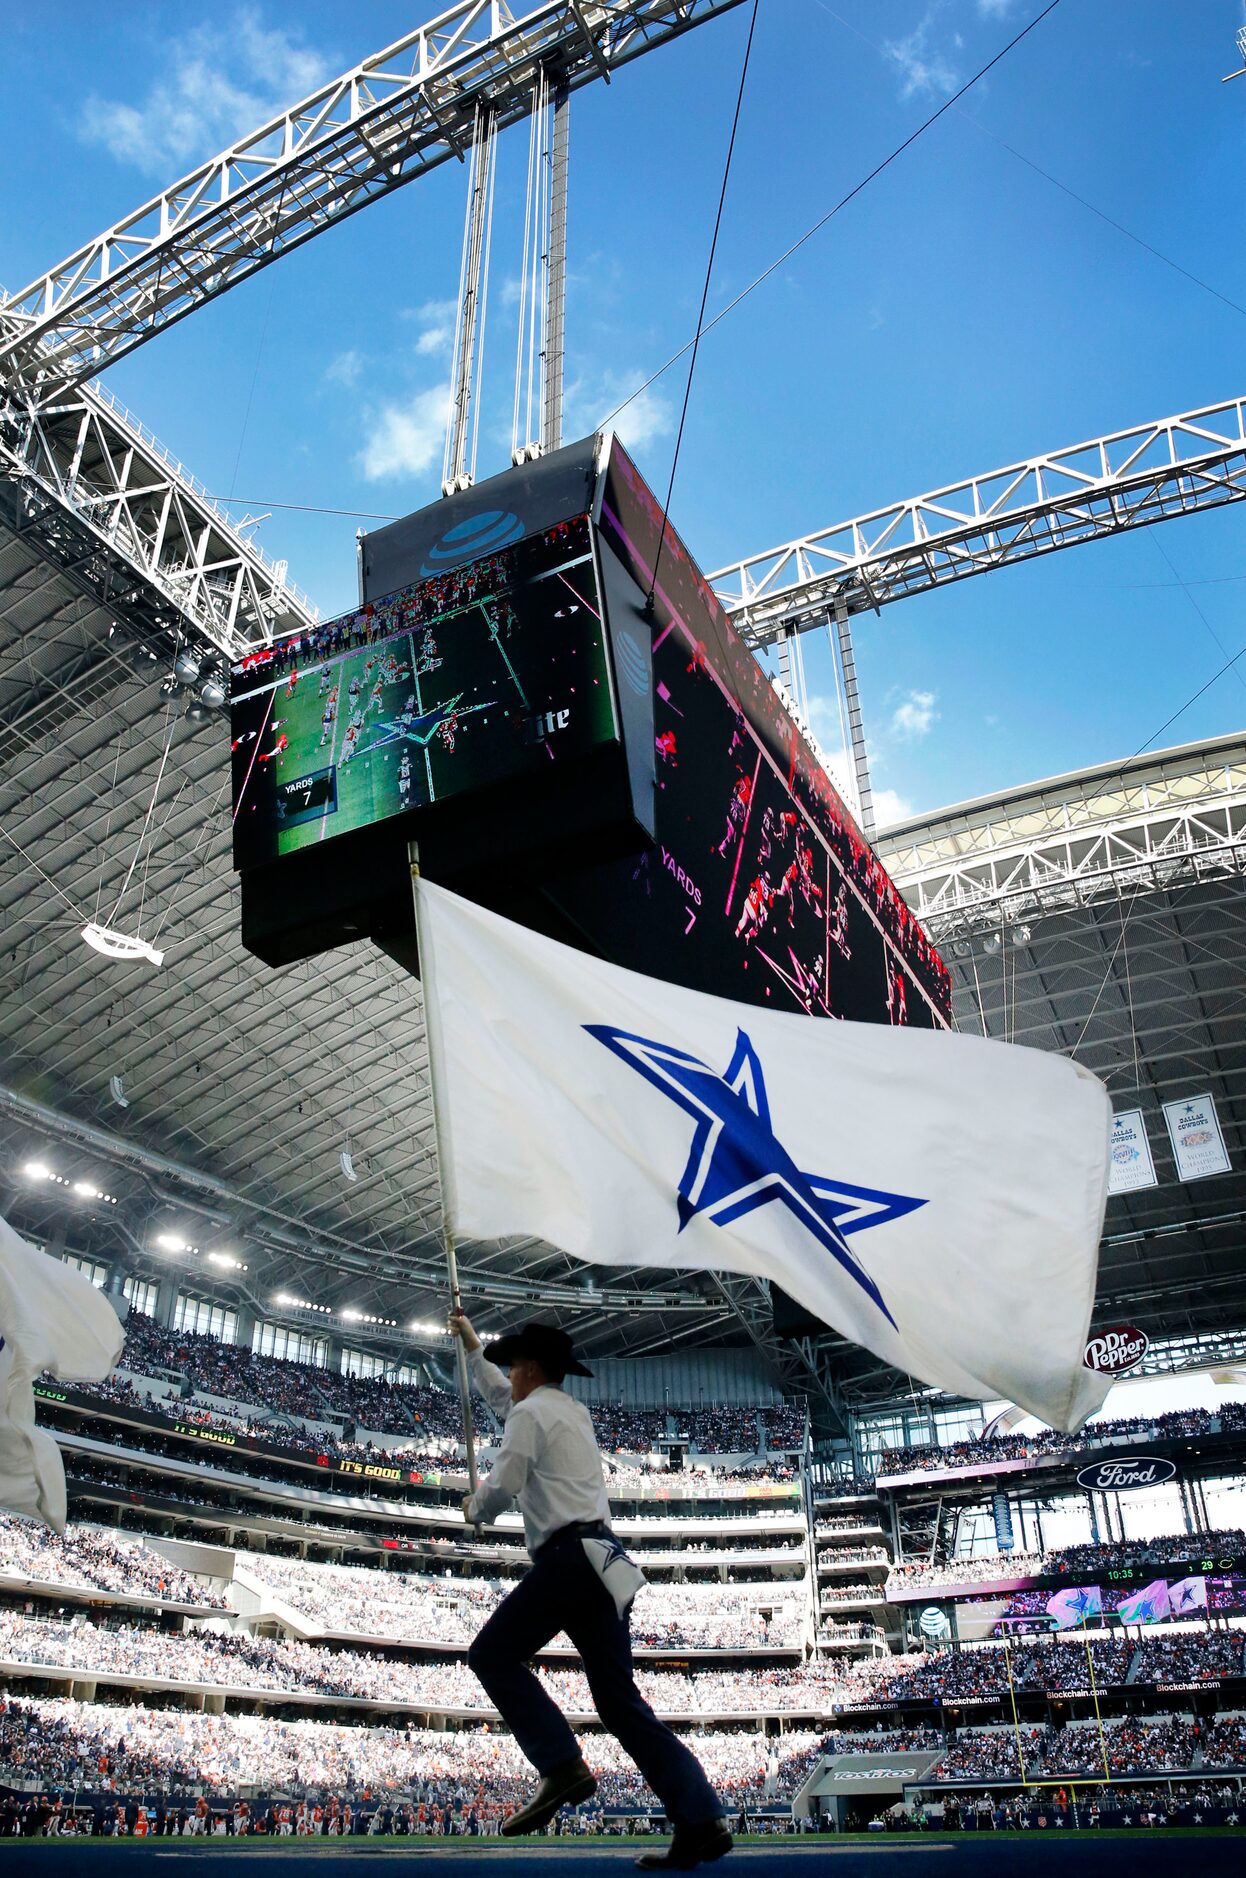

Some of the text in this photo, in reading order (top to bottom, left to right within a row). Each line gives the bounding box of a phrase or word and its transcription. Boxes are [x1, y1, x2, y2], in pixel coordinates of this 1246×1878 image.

[285, 777, 313, 794] YARDS
[303, 791, 311, 806] 7
[661, 845, 701, 905] YARDS
[1179, 1113, 1204, 1124] DALLAS
[1177, 1119, 1208, 1130] COWBOYS
[1110, 1134, 1137, 1144] OWBOYS
[1187, 1151, 1214, 1160] WORLD
[1181, 1156, 1224, 1169] CHAMPIONS
[1104, 1332, 1128, 1351] Dr
[1086, 1338, 1144, 1369] Pepper
[340, 1460, 363, 1474] IT'S
[364, 1465, 400, 1480] GOOD
[1096, 1461, 1156, 1487] Ford
[1201, 1560, 1213, 1570] 29
[1108, 1570, 1133, 1580] 10:35
[1156, 1681, 1221, 1691] Blockchain.com
[1046, 1689, 1107, 1699] Blockchain.com
[942, 1695, 1000, 1706] Blockchain.com
[843, 1702, 898, 1711] Blockchain.com
[833, 1768, 917, 1780] Tostitos
